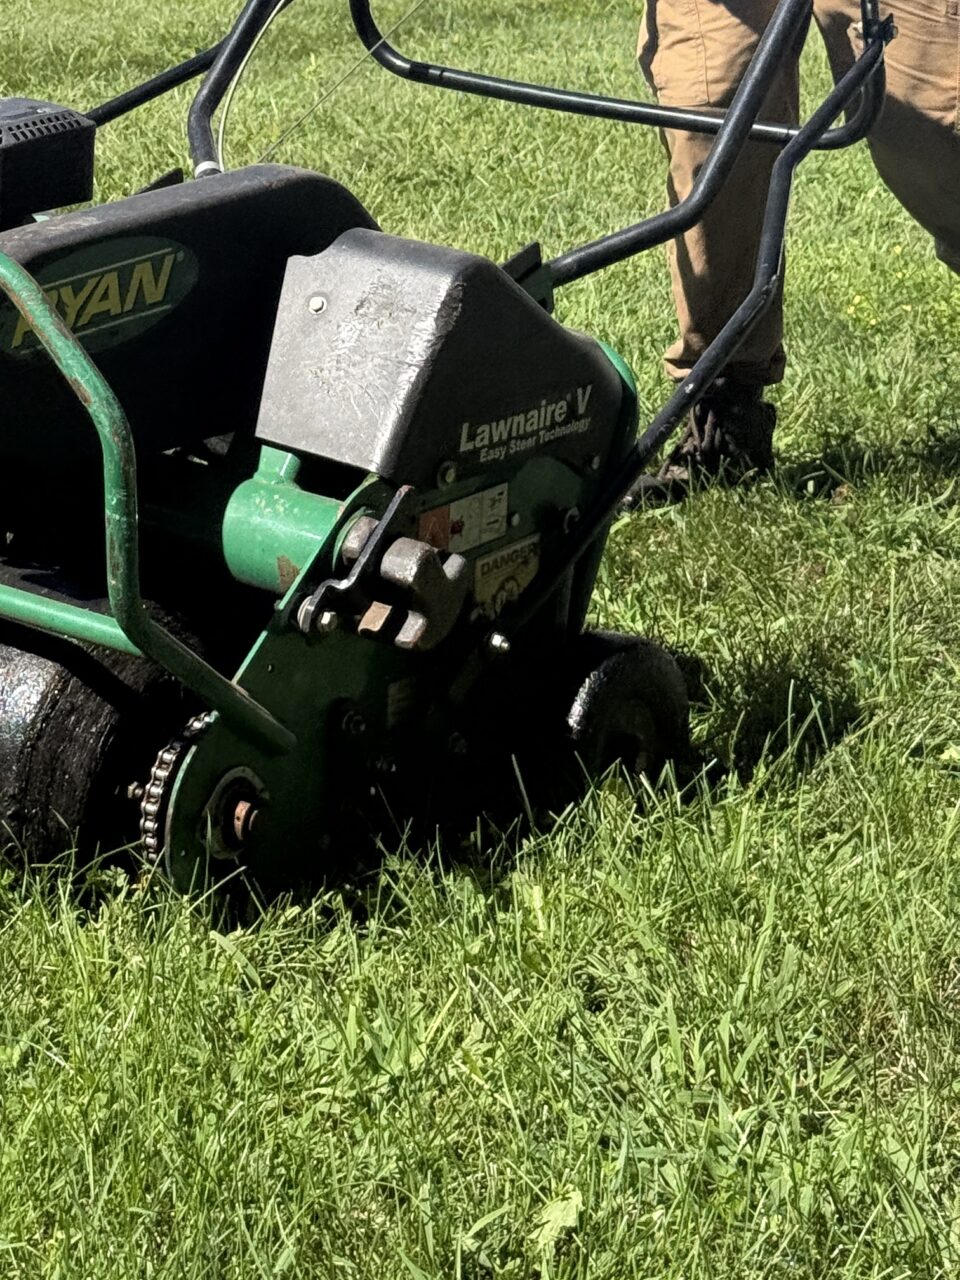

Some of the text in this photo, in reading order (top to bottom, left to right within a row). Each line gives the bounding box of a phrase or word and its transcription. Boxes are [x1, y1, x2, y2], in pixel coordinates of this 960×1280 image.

[459, 384, 592, 452] Lawnaire V
[480, 417, 592, 462] Easy Steer Technology
[481, 542, 538, 577] DANGER
